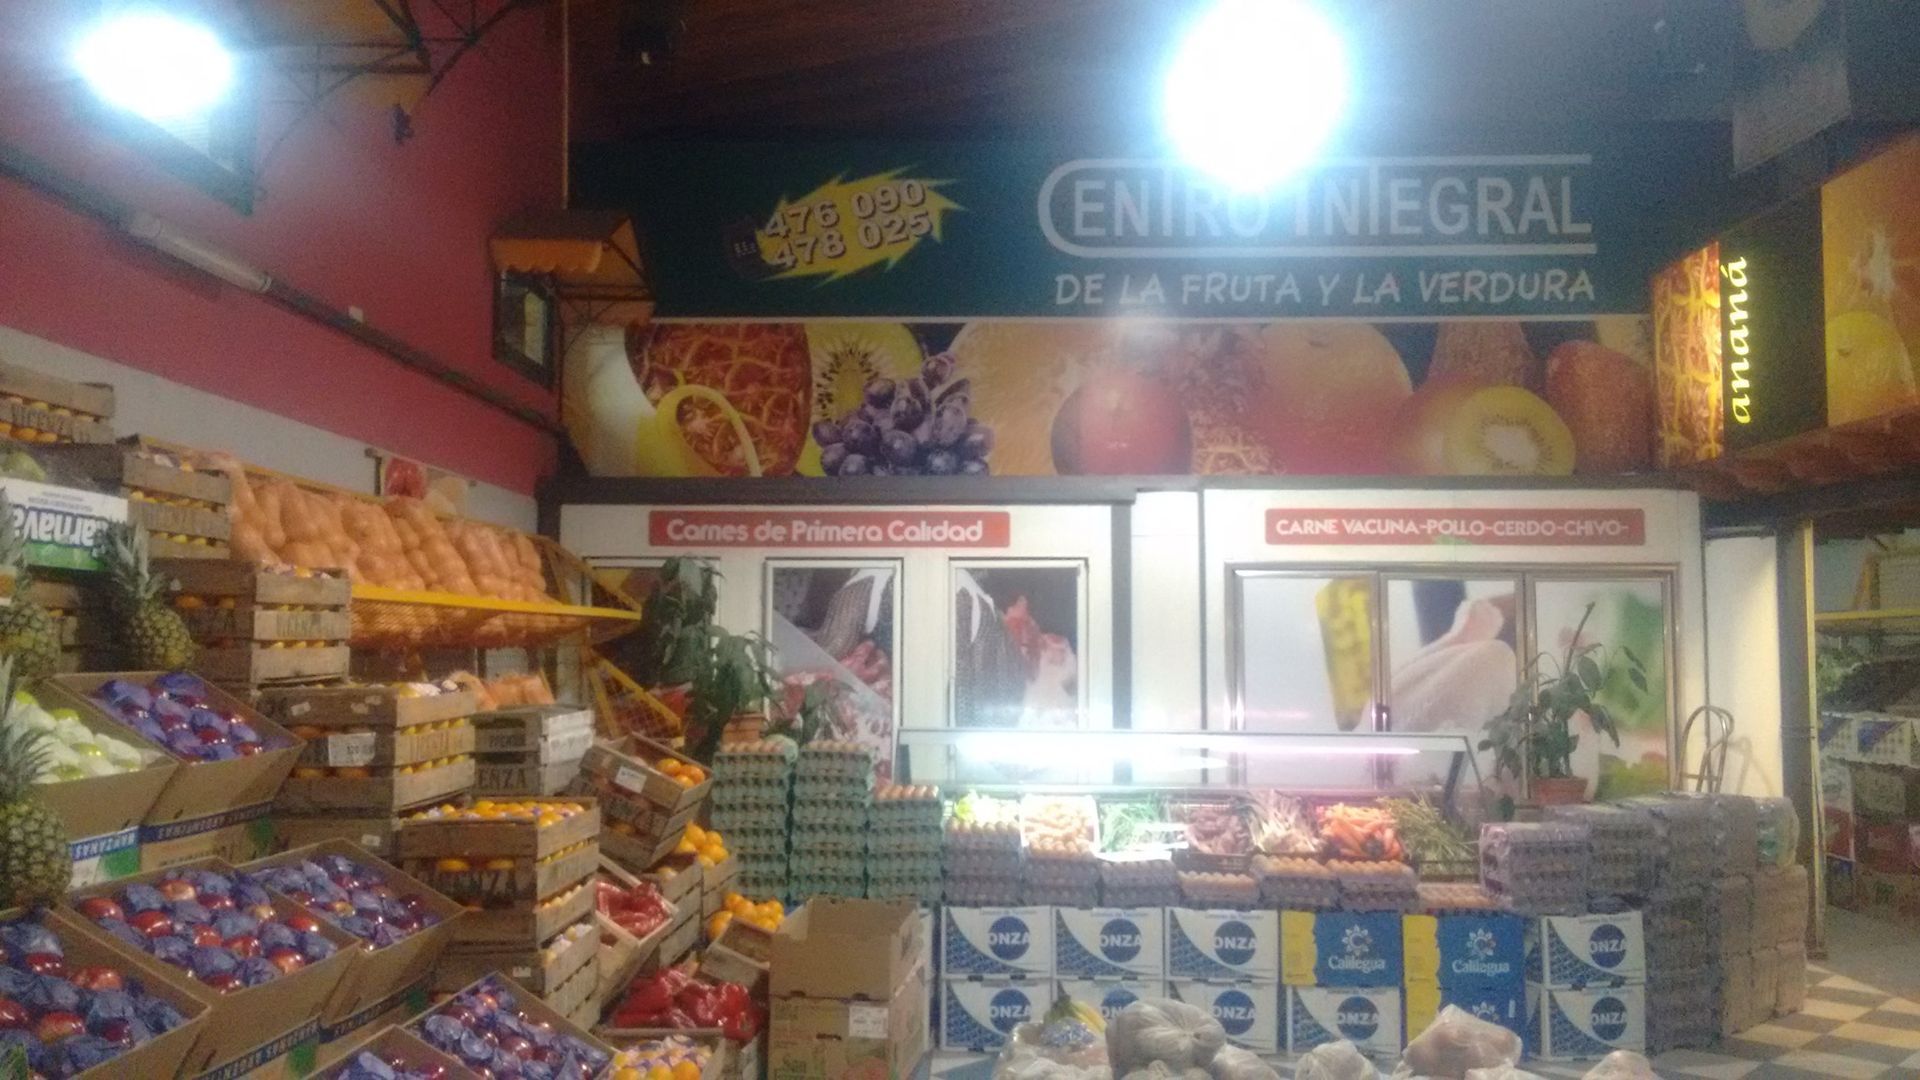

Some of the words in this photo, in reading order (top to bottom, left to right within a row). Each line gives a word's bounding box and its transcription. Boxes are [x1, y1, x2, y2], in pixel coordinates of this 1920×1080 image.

[764, 201, 841, 238] 476
[852, 178, 927, 220] 090
[774, 228, 848, 269] 478
[857, 209, 934, 250] 025
[1054, 272, 1106, 305] DE
[1118, 272, 1166, 305] LA
[1181, 270, 1301, 305] FRUTA
[1318, 272, 1341, 306] Y
[1352, 271, 1400, 304] LA
[1418, 268, 1596, 304] VERDURA
[1719, 256, 1752, 425] ananá
[666, 518, 749, 542] Carnes
[754, 518, 787, 542] de
[791, 518, 883, 542] Primera
[887, 518, 984, 542] Calidad
[1275, 518, 1339, 536] CARNE
[987, 931, 1031, 946] ONZA
[1100, 933, 1142, 948] ONZA
[1213, 935, 1257, 951] ONZA
[989, 1004, 1032, 1019] ONZA
